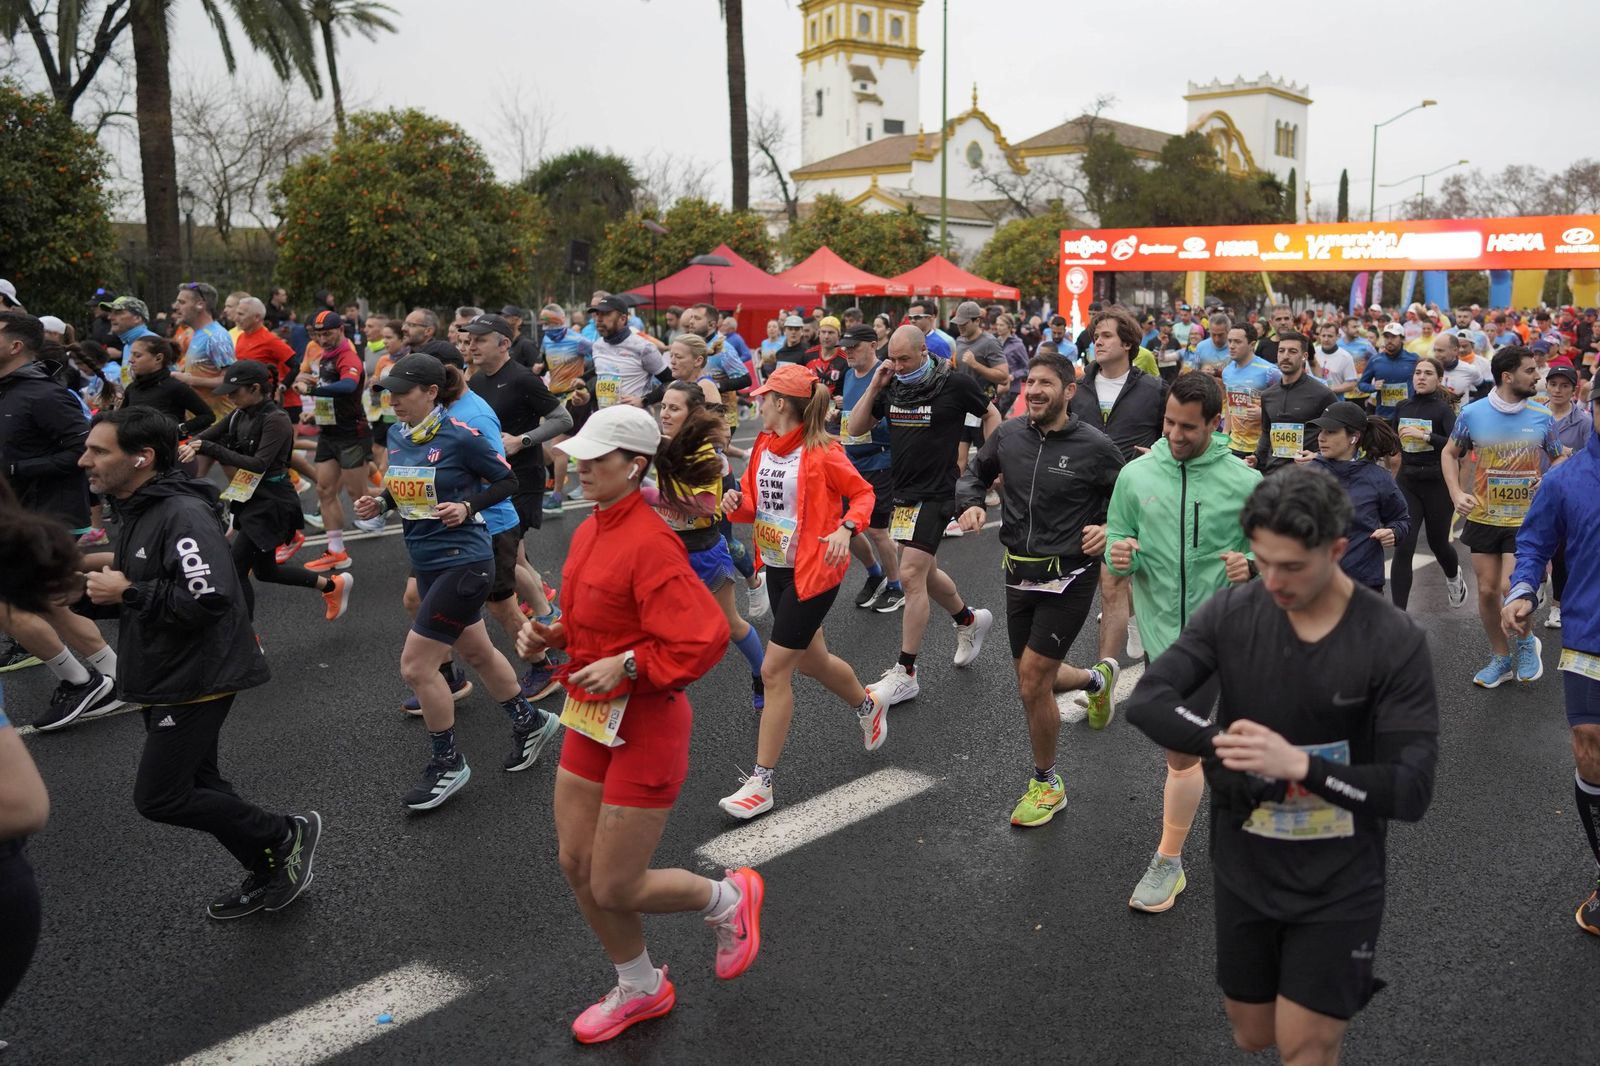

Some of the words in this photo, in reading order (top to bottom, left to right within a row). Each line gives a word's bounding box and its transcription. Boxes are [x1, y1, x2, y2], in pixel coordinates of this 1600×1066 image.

[1486, 233, 1546, 252] HOKA
[1272, 431, 1297, 443] 15468
[759, 467, 771, 477] 42
[770, 469, 787, 479] KM
[387, 479, 425, 497] 15037
[760, 479, 769, 488] 21
[770, 480, 783, 490] KM
[761, 491, 770, 499] 15
[771, 491, 784, 501] KM
[1491, 487, 1529, 500] 14209
